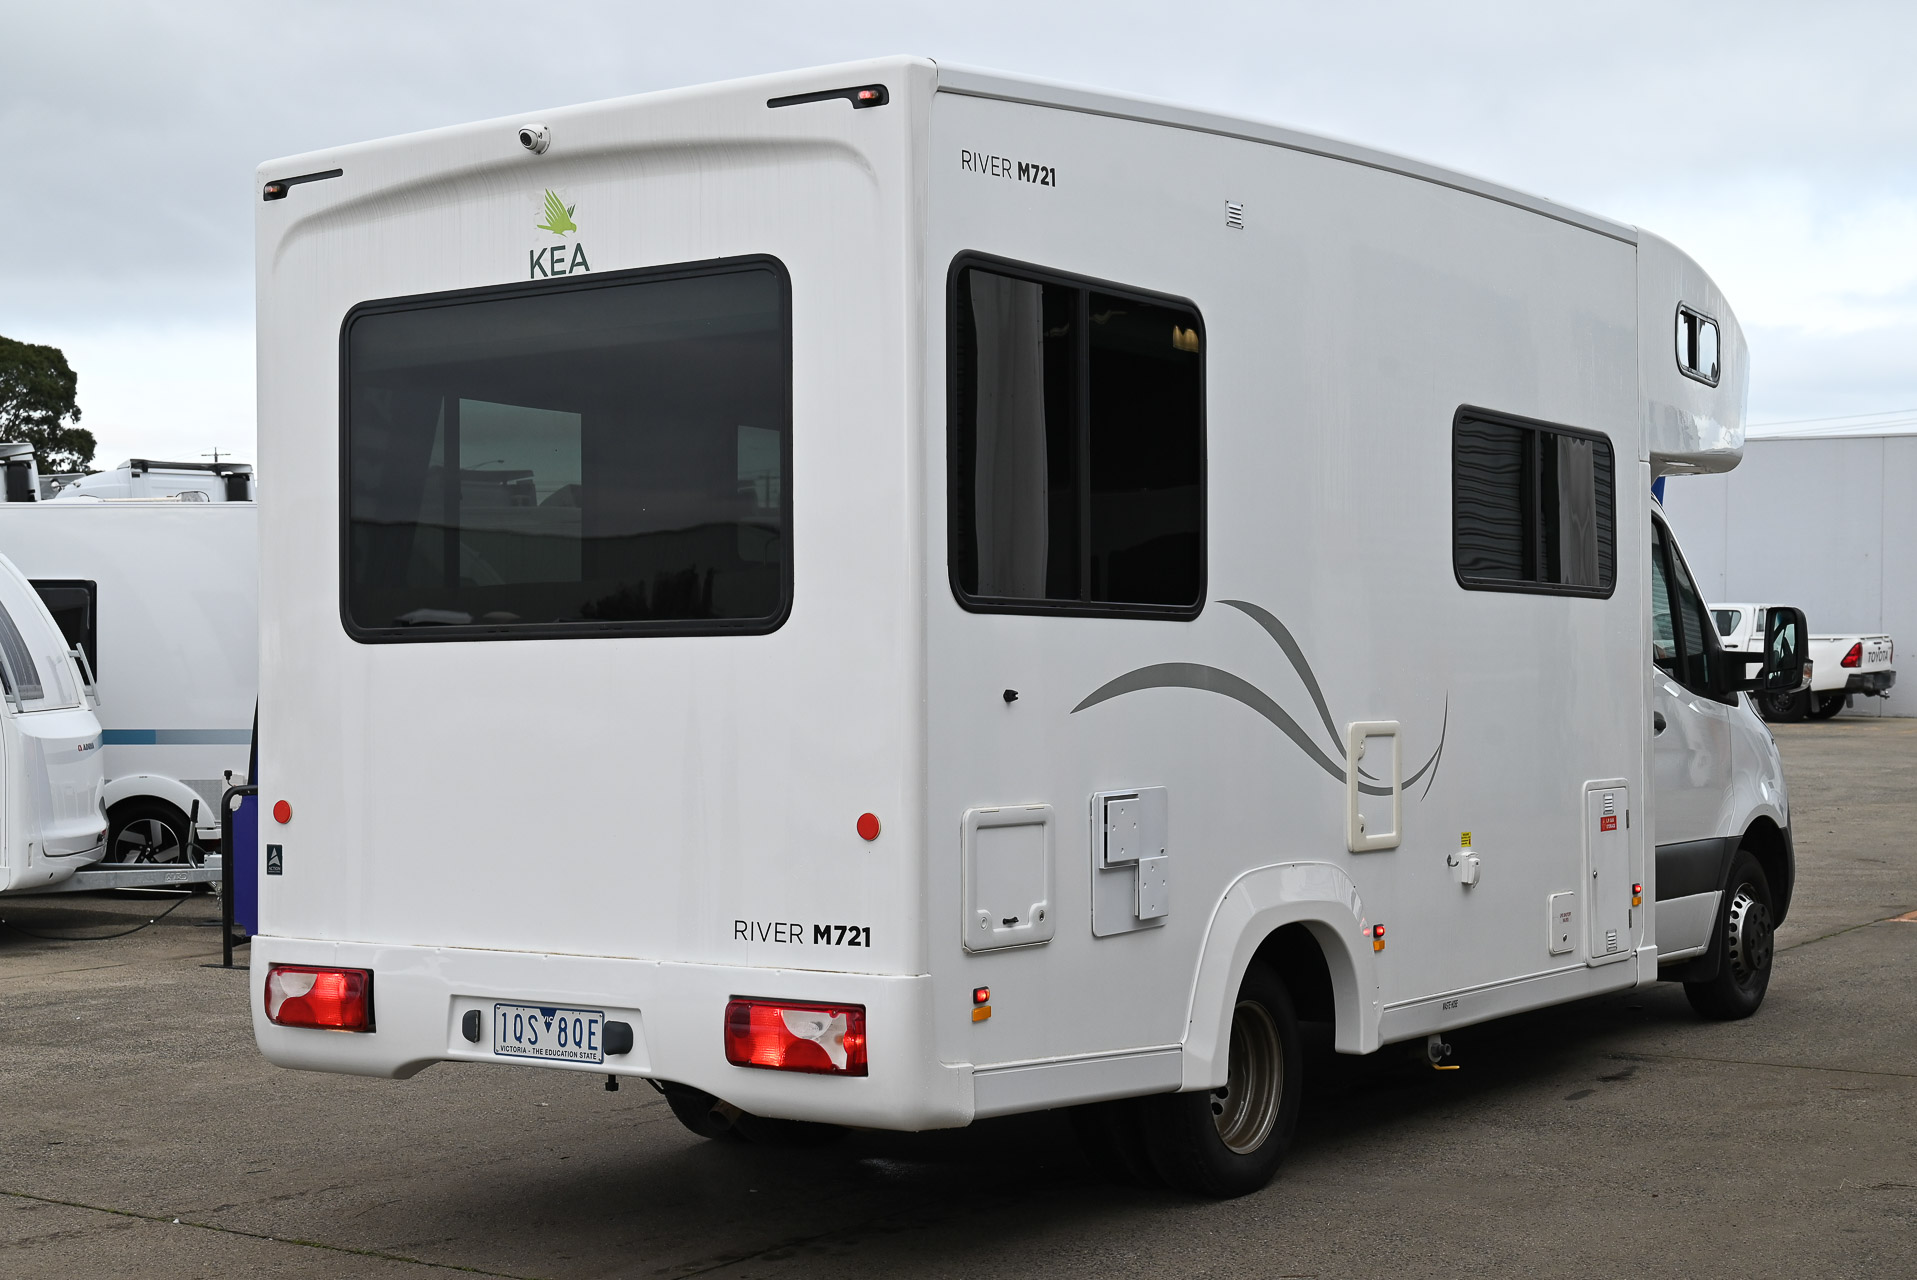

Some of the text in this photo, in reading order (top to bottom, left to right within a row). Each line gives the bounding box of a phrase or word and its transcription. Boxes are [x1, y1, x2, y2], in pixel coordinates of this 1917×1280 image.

[961, 149, 1056, 188] RIVER M721
[529, 242, 591, 280] KEA
[1868, 650, 1889, 663] TOYOTA
[734, 920, 871, 948] RIVER M721
[501, 1011, 599, 1051] 1QS 8QE
[500, 1044, 527, 1054] VICTORIA
[532, 1047, 544, 1056] THE
[544, 1048, 578, 1058] EDUCATION
[579, 1051, 597, 1060] STATE
